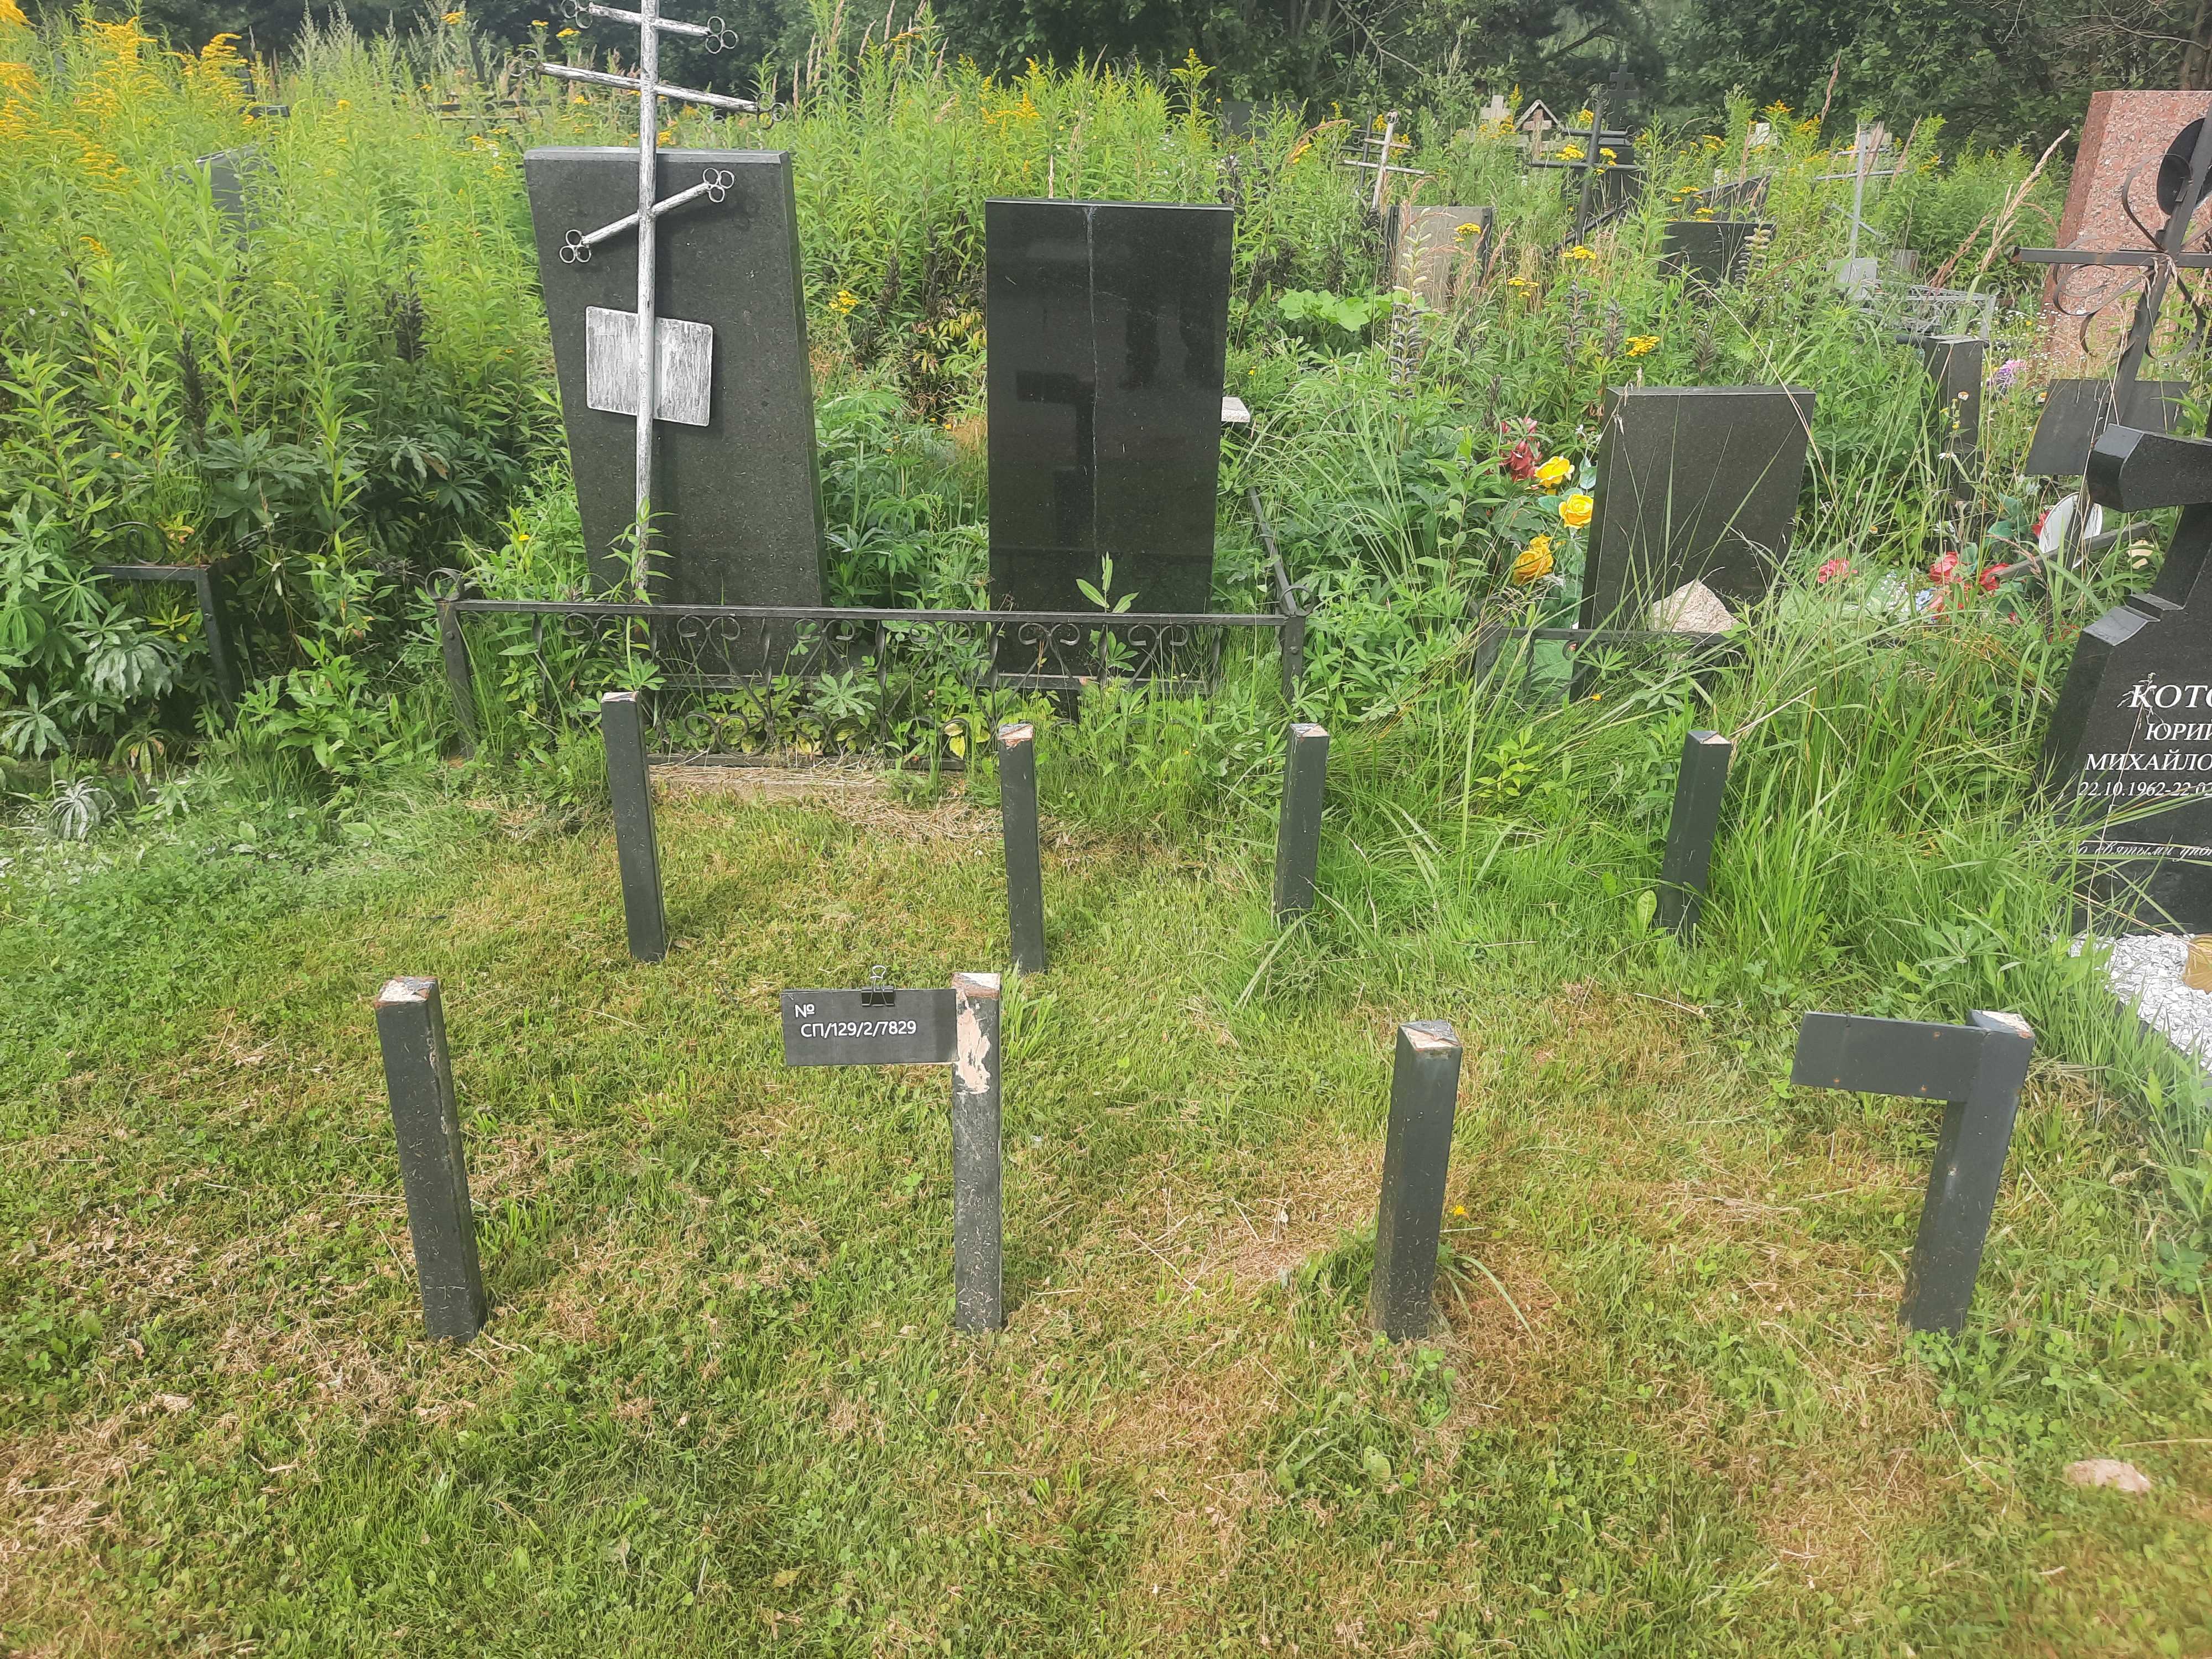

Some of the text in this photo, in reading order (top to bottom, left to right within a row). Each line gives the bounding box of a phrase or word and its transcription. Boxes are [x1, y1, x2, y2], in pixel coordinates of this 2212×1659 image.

[2127, 685, 2212, 708] КОТ
[794, 1004, 815, 1018] №
[800, 1020, 917, 1039] СП/129/2/7829
